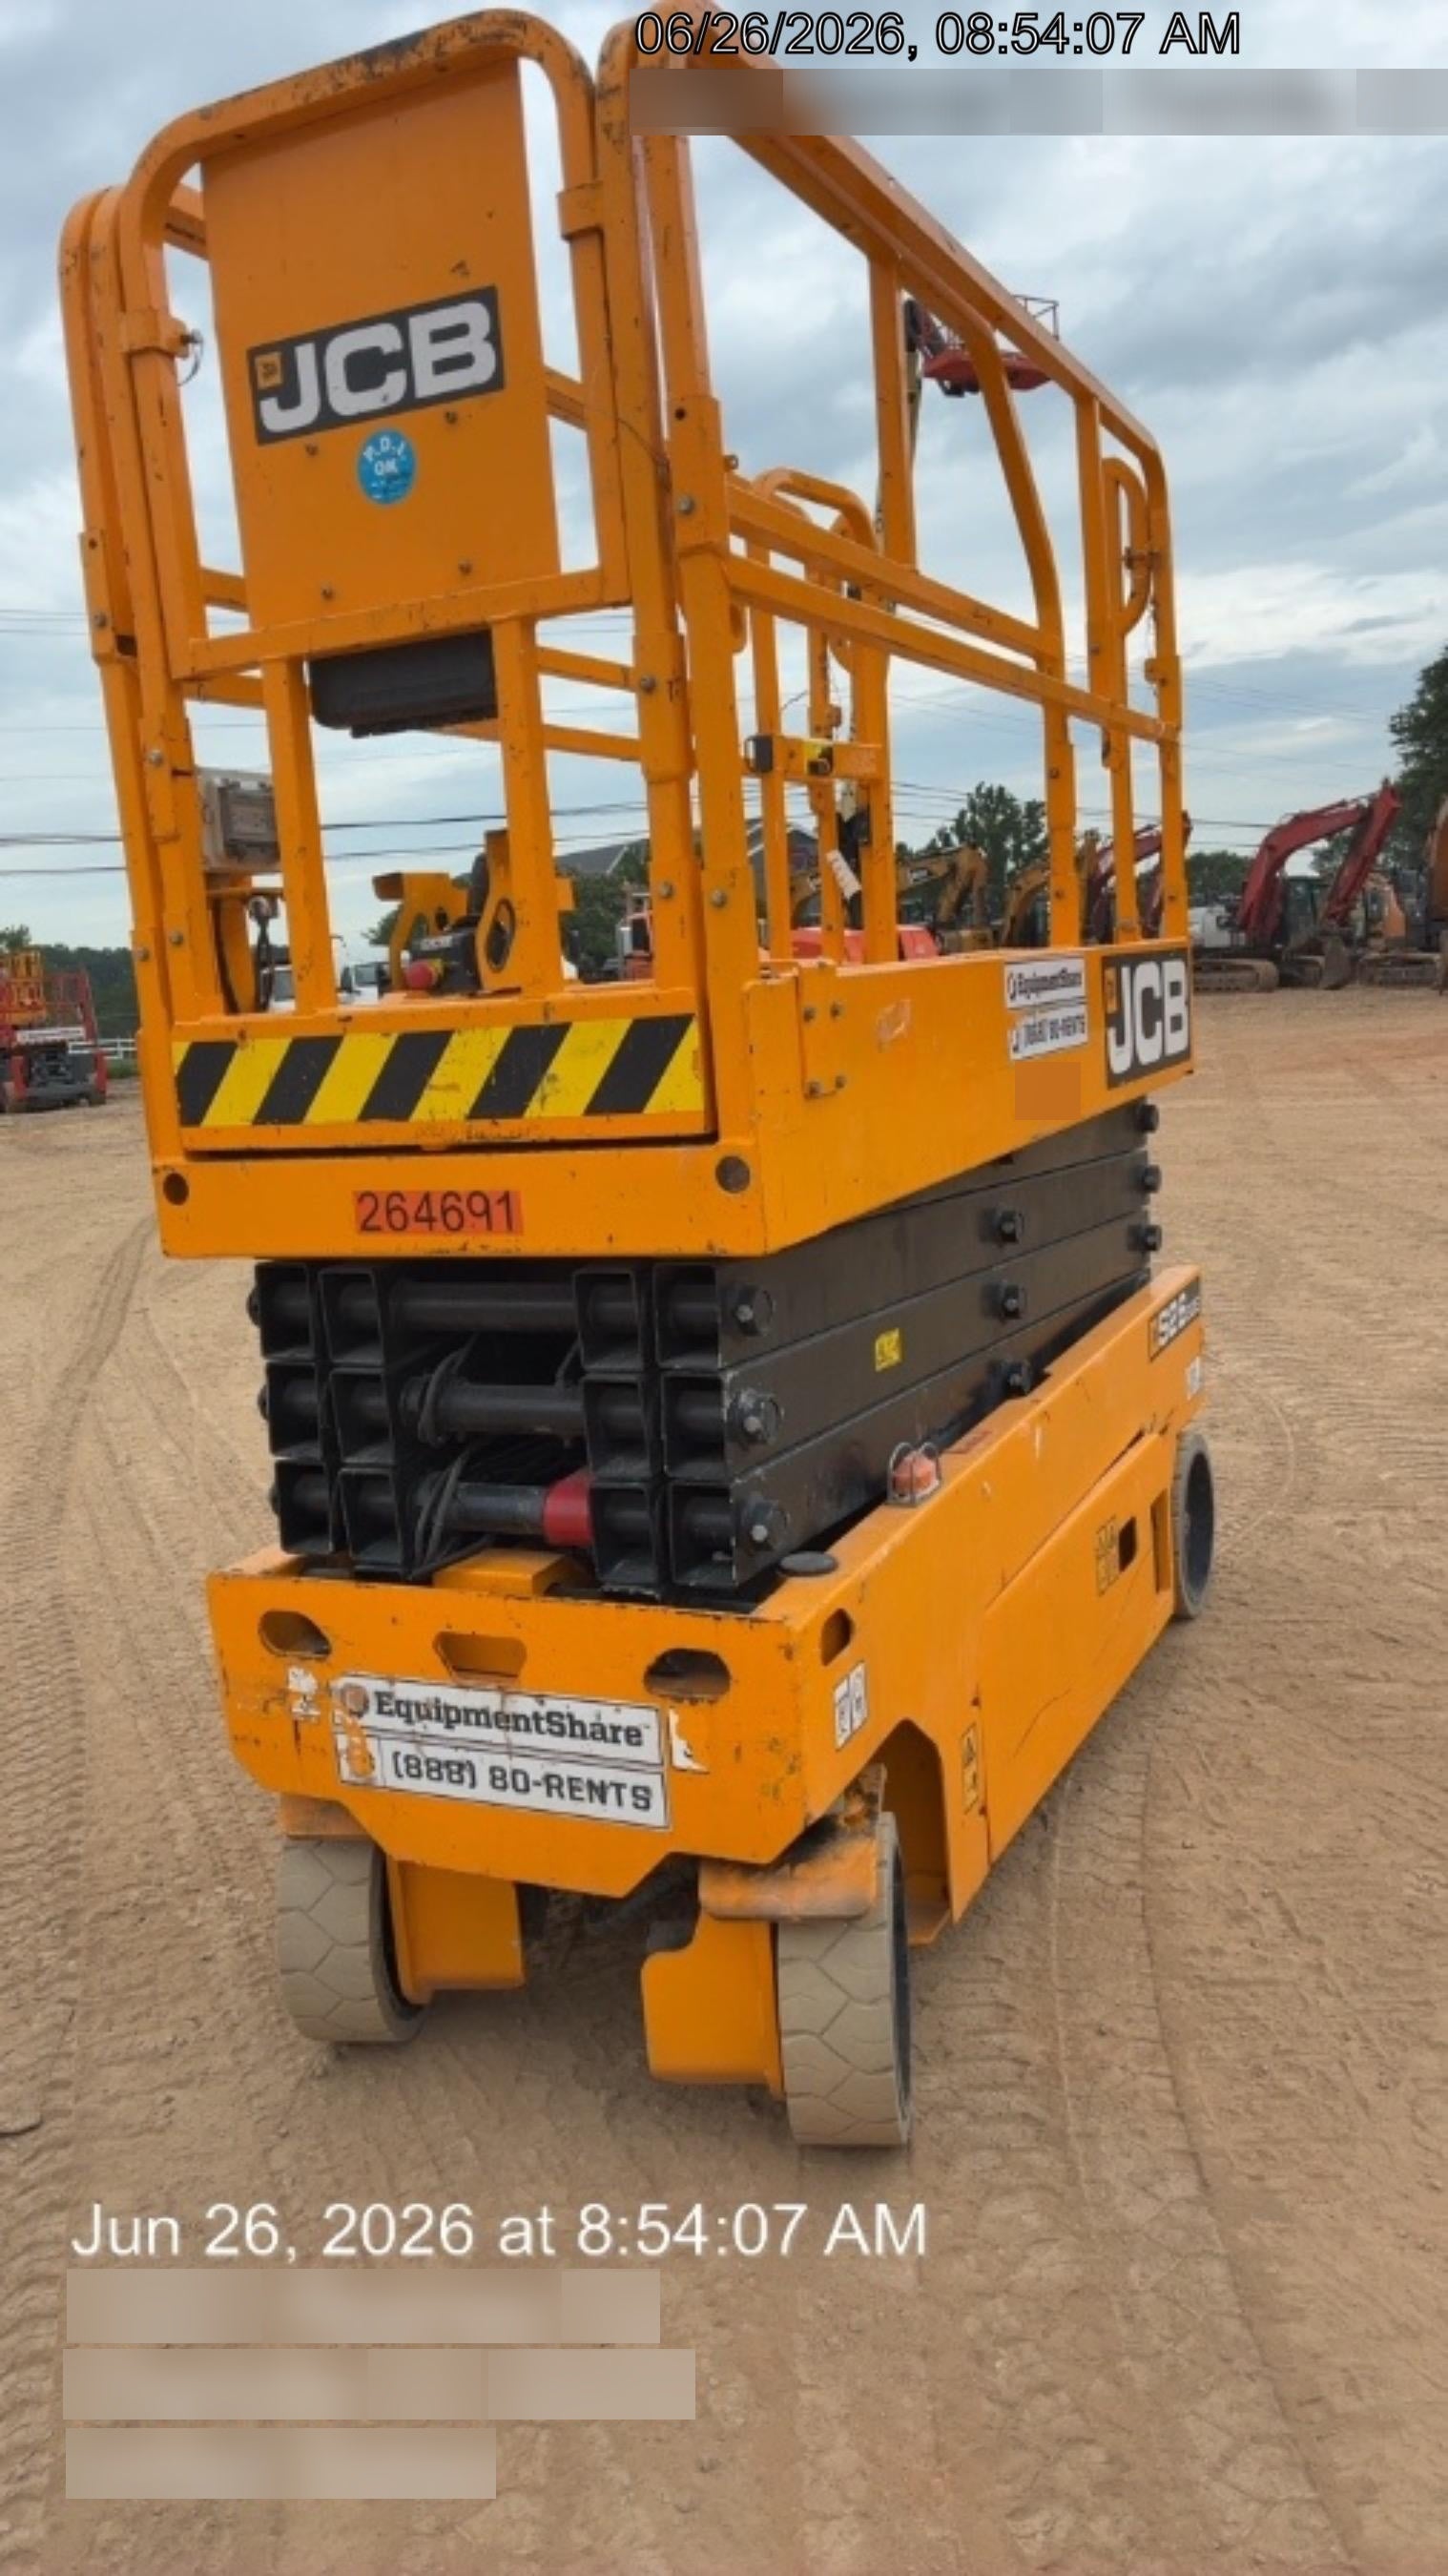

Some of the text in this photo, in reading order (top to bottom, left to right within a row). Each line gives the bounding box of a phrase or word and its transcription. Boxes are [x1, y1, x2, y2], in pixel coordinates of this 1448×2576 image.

[259, 301, 497, 434] JCB
[1107, 960, 1189, 1074] JCB
[357, 1190, 513, 1232] 264691
[374, 1690, 643, 1748] EquipmentShare
[392, 1750, 652, 1811] (888) 80-RENTS
